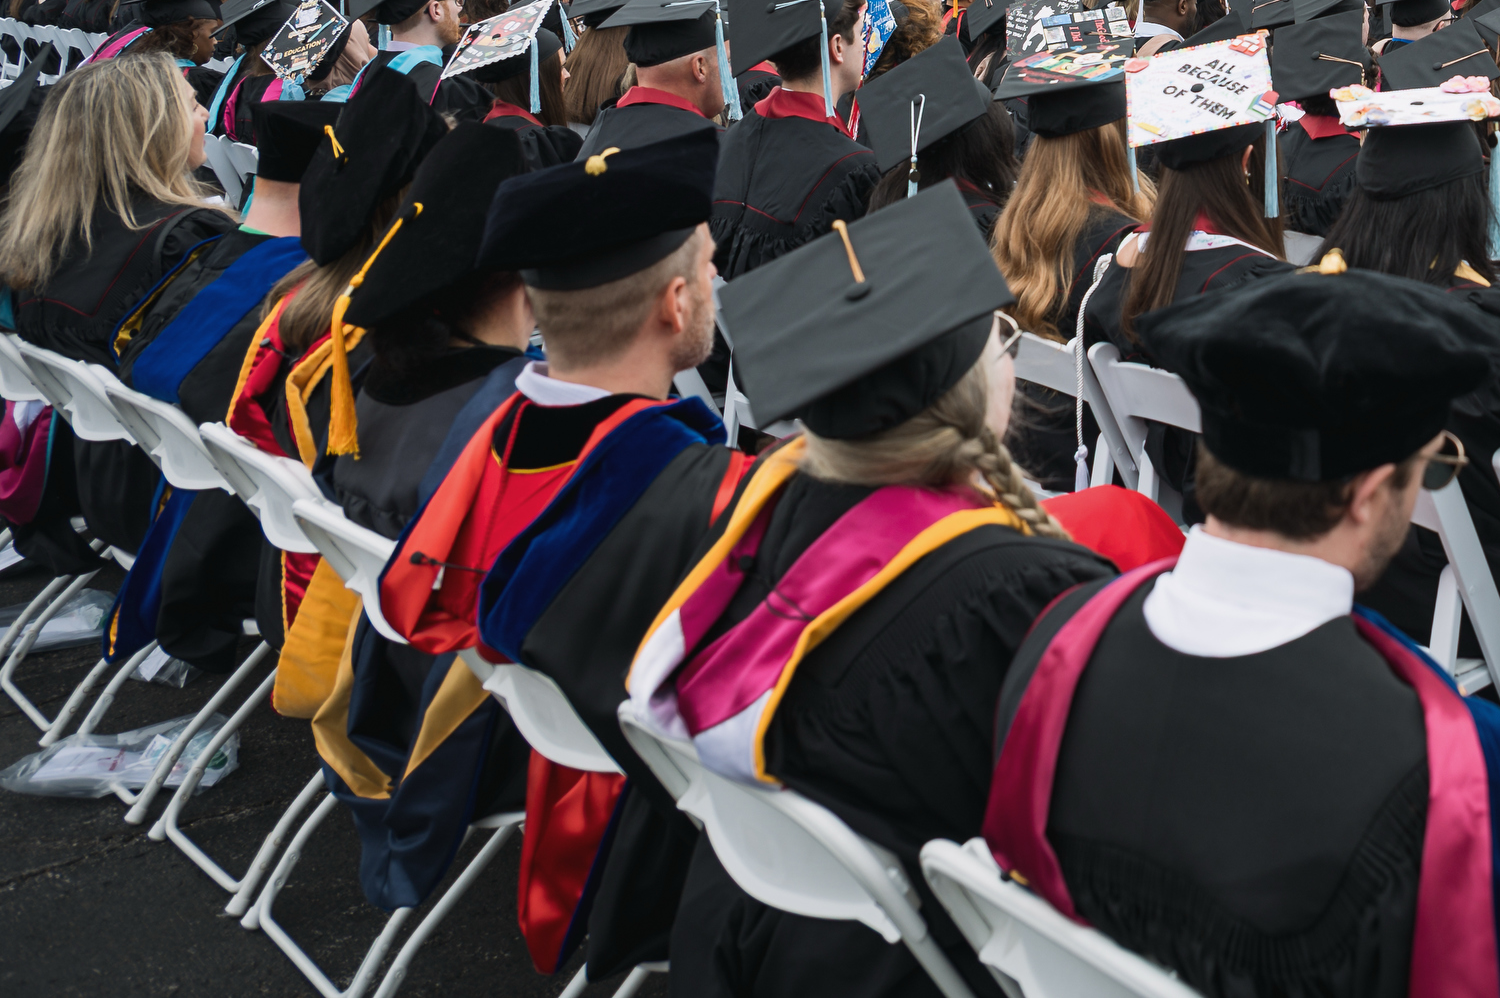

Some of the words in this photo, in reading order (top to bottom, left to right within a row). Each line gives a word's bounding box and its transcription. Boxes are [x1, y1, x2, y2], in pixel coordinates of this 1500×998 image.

[284, 39, 322, 57] EDUCATION
[1205, 59, 1236, 74] ALL
[1177, 63, 1249, 95] BECAUSE
[1163, 85, 1188, 98] OF
[1190, 94, 1237, 120] THEM
